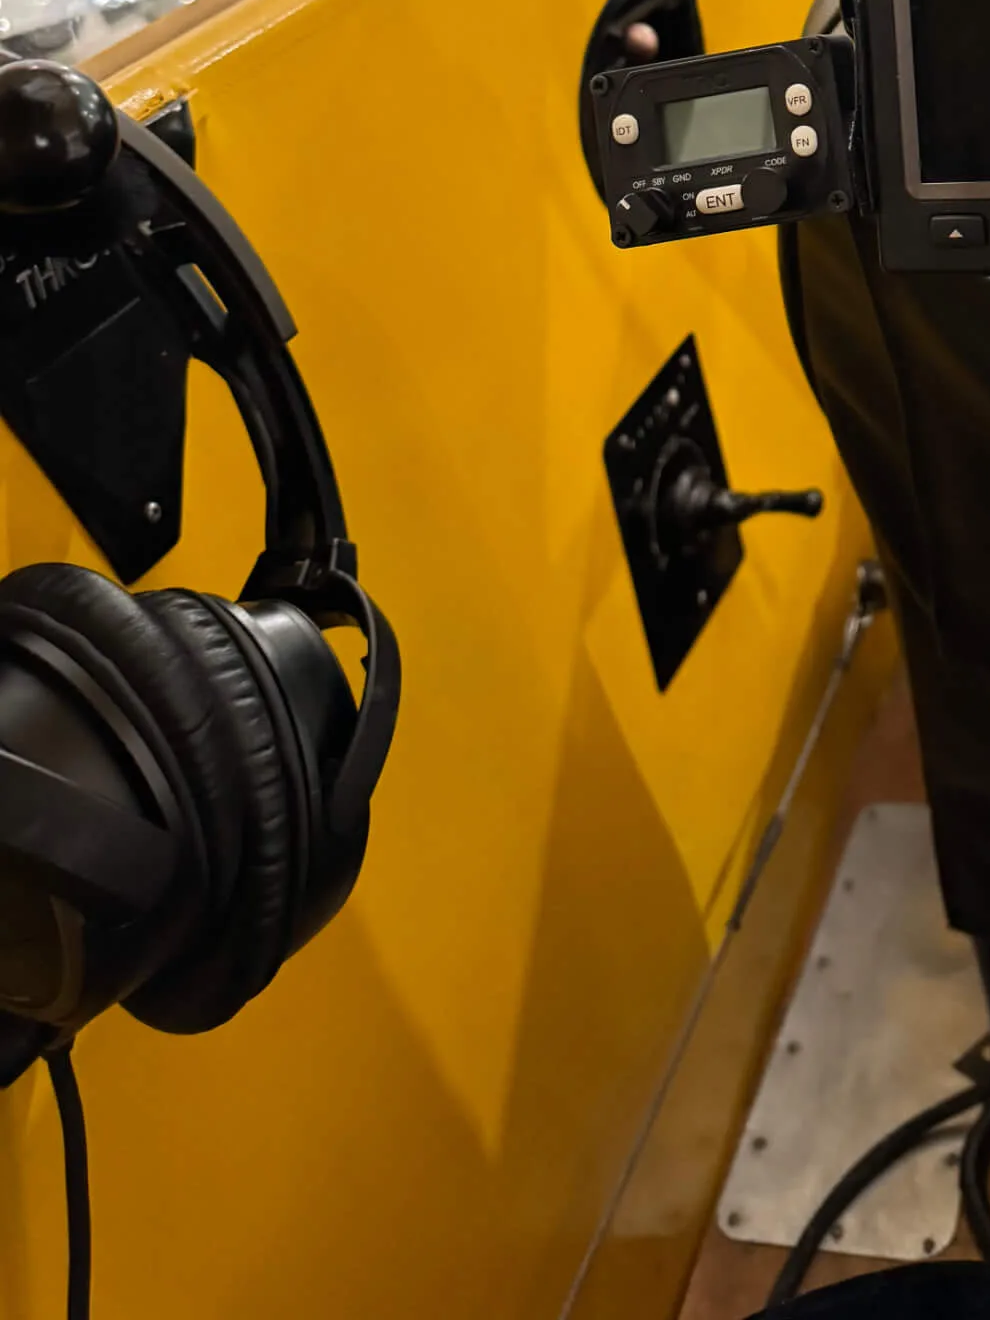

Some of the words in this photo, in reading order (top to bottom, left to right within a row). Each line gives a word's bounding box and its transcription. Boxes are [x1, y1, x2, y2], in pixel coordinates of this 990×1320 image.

[787, 95, 807, 107] VFR
[615, 126, 631, 136] IDT
[795, 138, 810, 148] FN
[764, 156, 787, 168] CODE
[710, 164, 733, 176] XPDR
[632, 180, 647, 190] OFF
[651, 176, 666, 186] SBY
[672, 173, 692, 184] GND
[682, 192, 695, 201] ON
[705, 192, 736, 209] ENT
